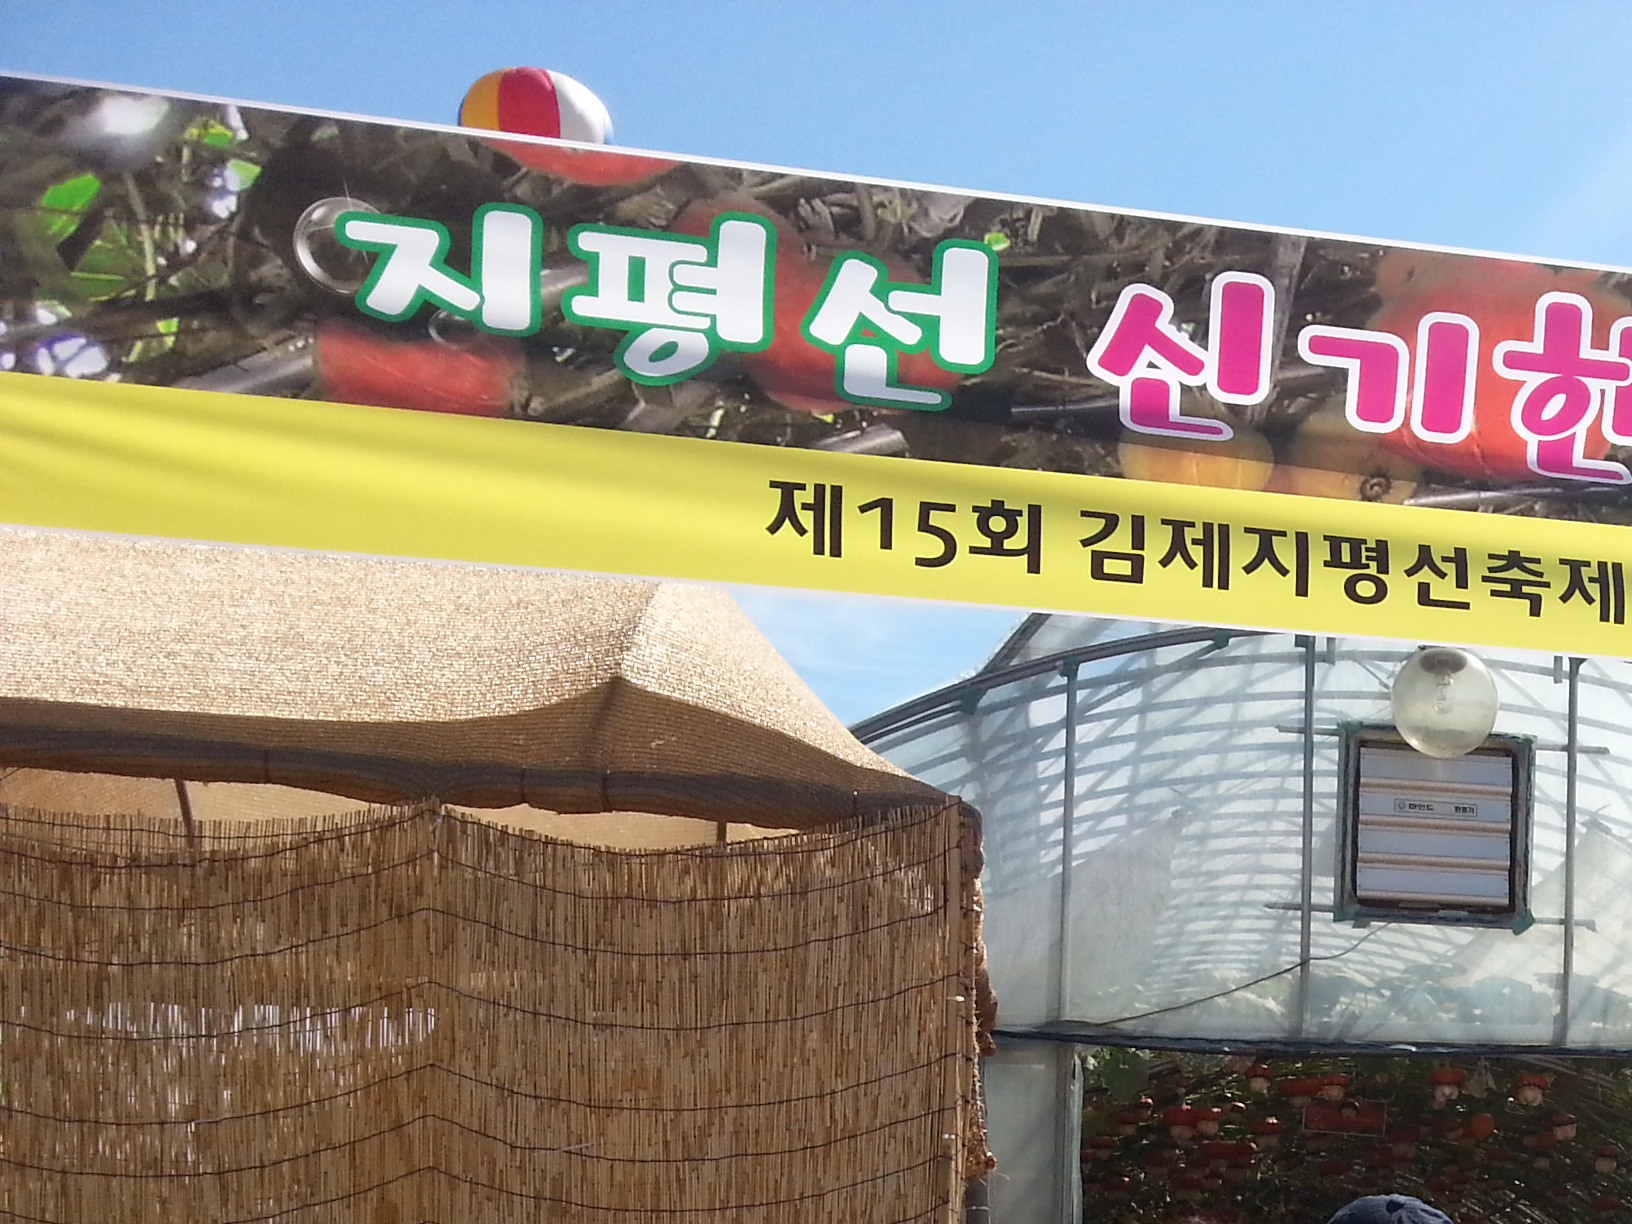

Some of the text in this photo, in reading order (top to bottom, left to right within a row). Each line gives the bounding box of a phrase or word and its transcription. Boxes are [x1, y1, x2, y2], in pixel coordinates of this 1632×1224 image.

[335, 203, 999, 410] 지평선
[766, 478, 1042, 574] 제15회
[1080, 509, 1627, 625] 김제지평선축제
